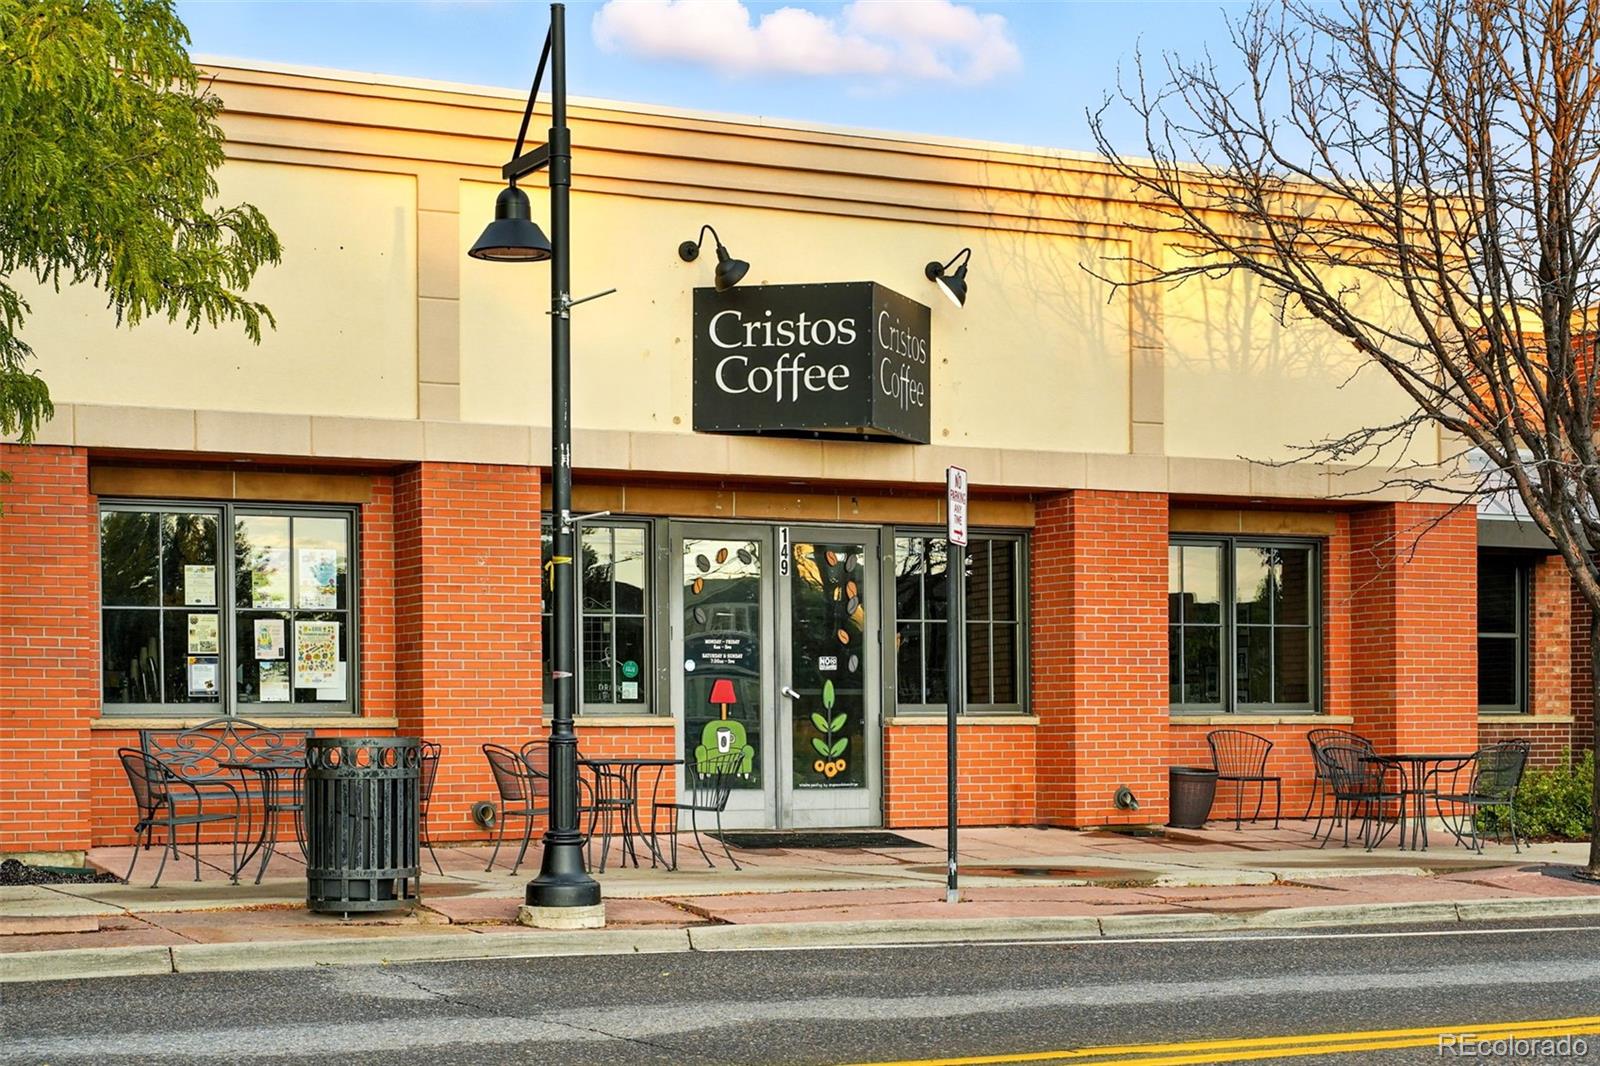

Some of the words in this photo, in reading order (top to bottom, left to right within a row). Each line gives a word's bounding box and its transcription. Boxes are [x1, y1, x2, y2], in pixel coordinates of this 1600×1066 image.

[709, 309, 857, 349] Cristos
[878, 310, 927, 365] Cristos
[715, 352, 850, 403] Coffee
[880, 357, 925, 411] Coffee
[950, 488, 966, 505] PARKING
[954, 474, 962, 490] NO
[781, 527, 789, 576] 149
